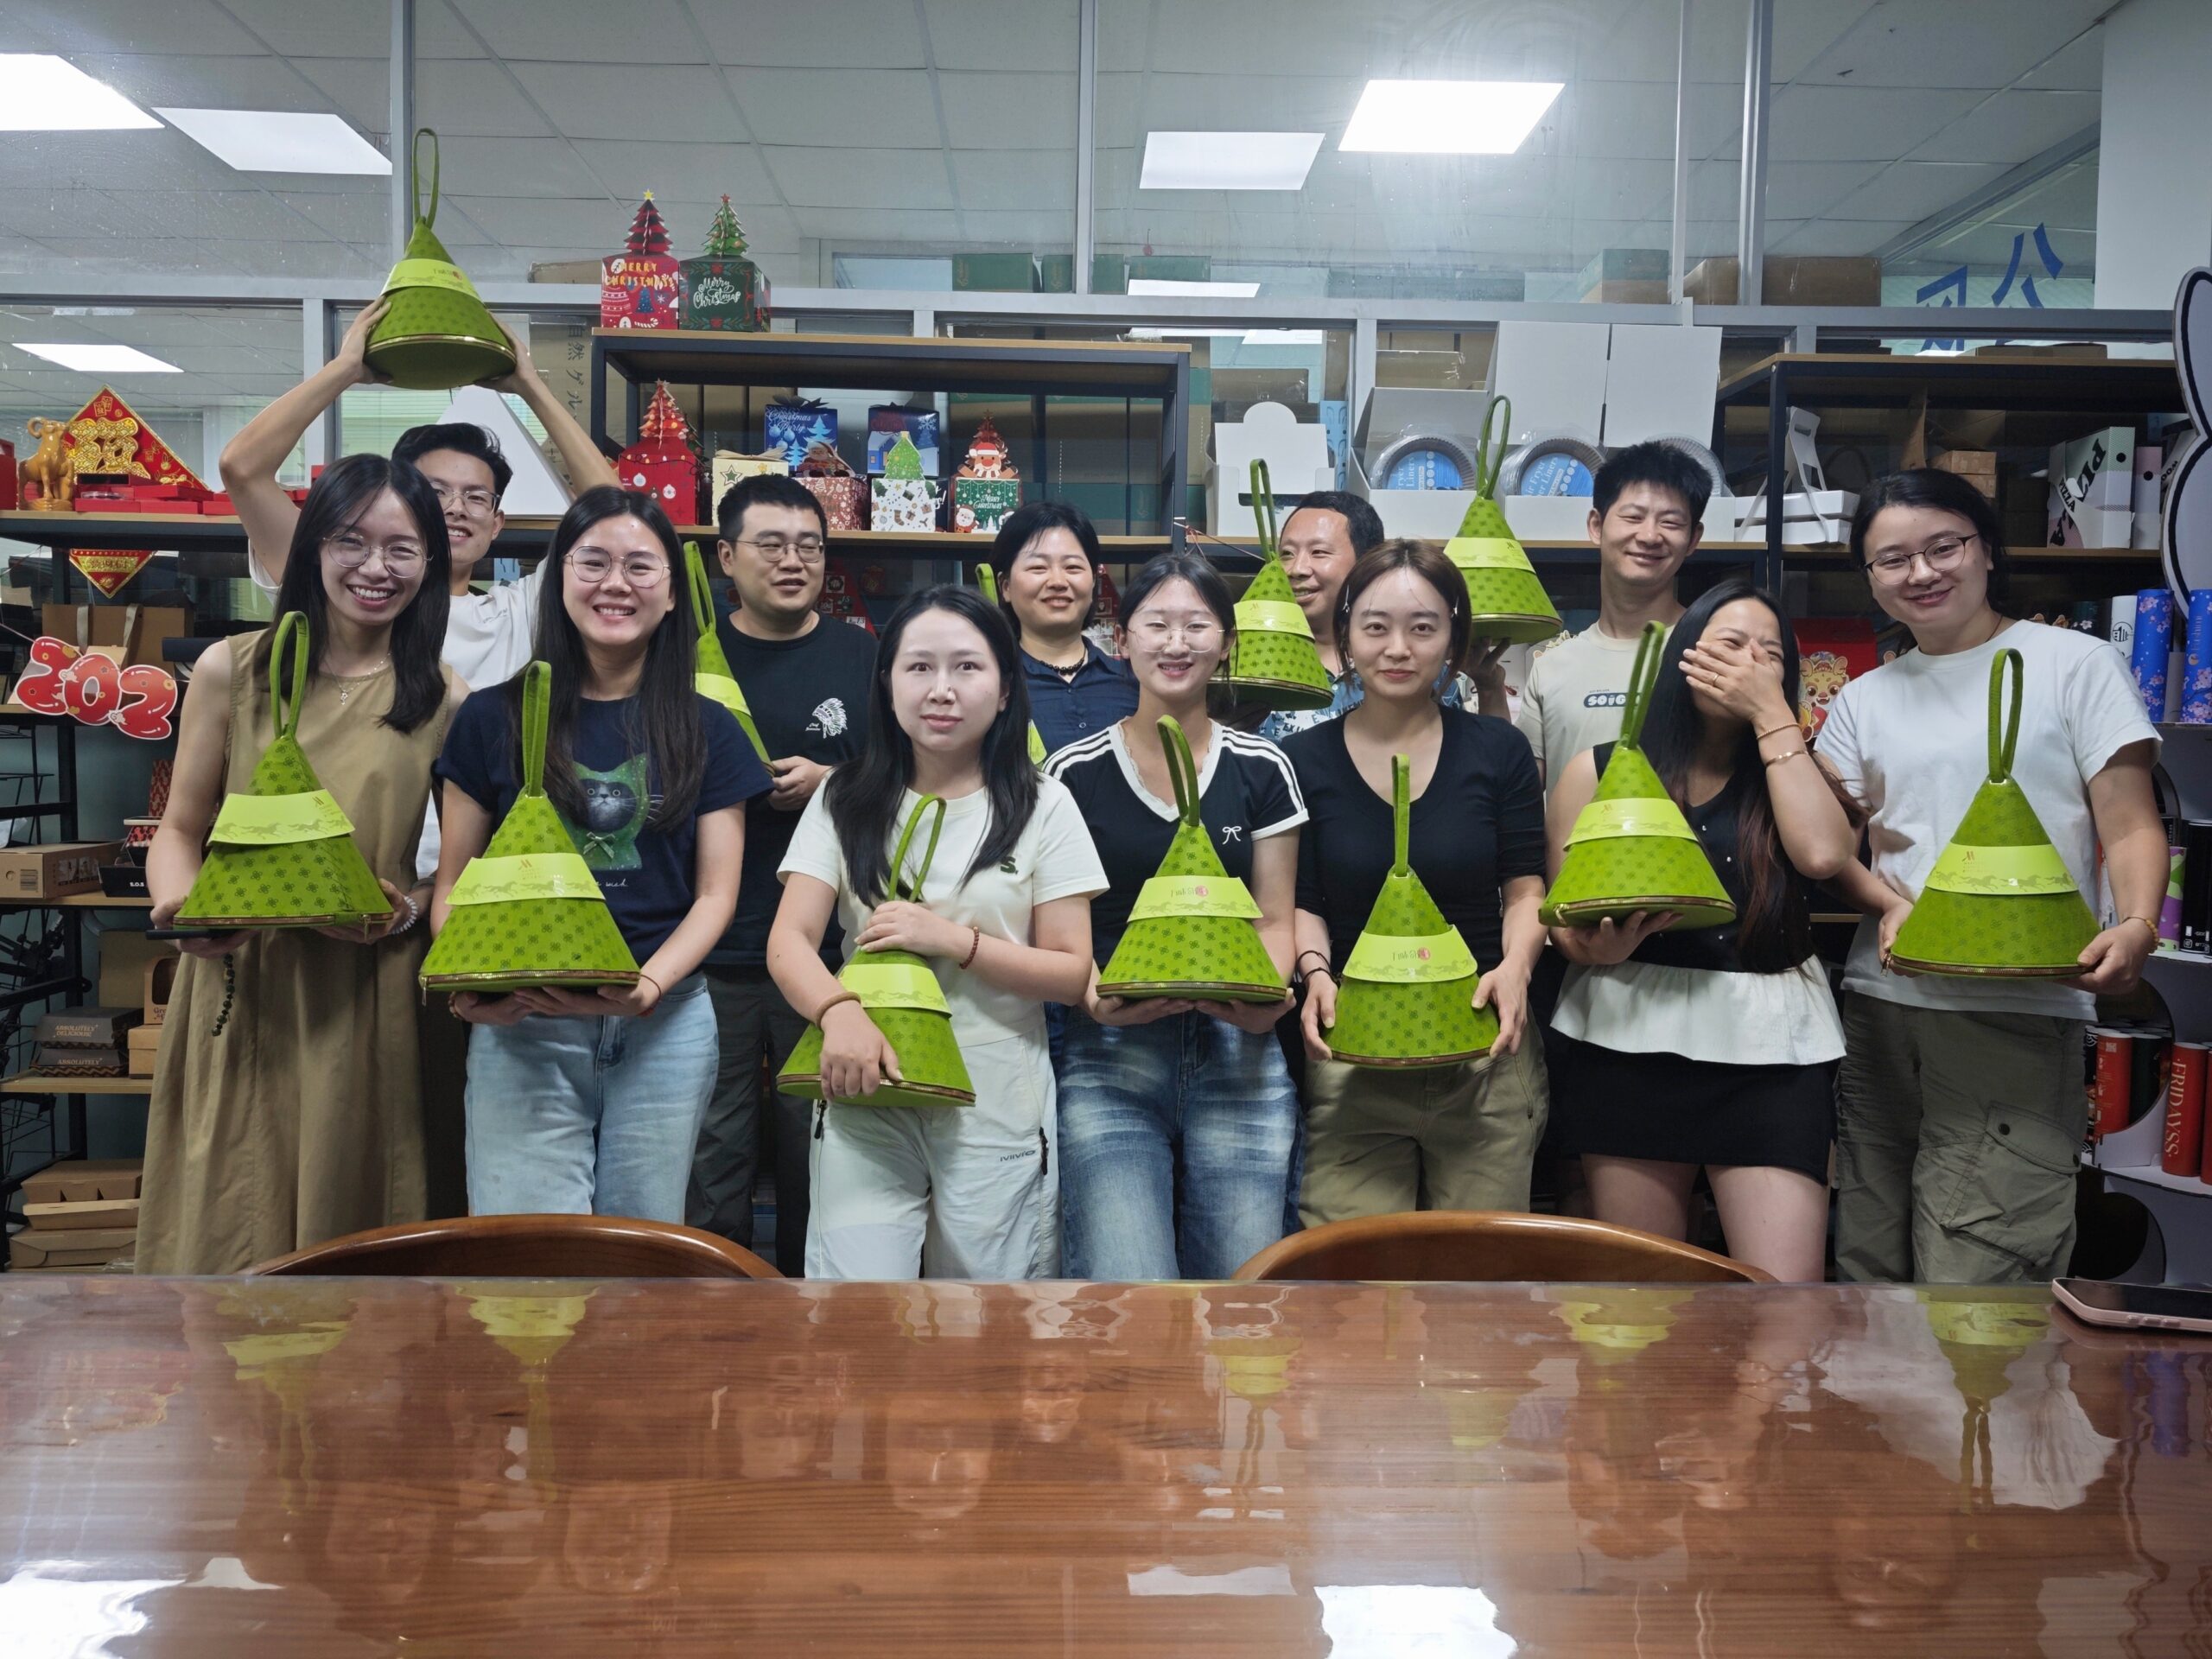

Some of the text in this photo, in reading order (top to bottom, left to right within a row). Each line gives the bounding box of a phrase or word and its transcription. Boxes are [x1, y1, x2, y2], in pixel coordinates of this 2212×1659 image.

[623, 262, 658, 273] MERRY
[697, 276, 734, 294] Merry
[693, 289, 741, 309] Christmas
[767, 409, 812, 423] Christmas
[779, 420, 806, 434] Party
[1529, 461, 1546, 486] Fryer
